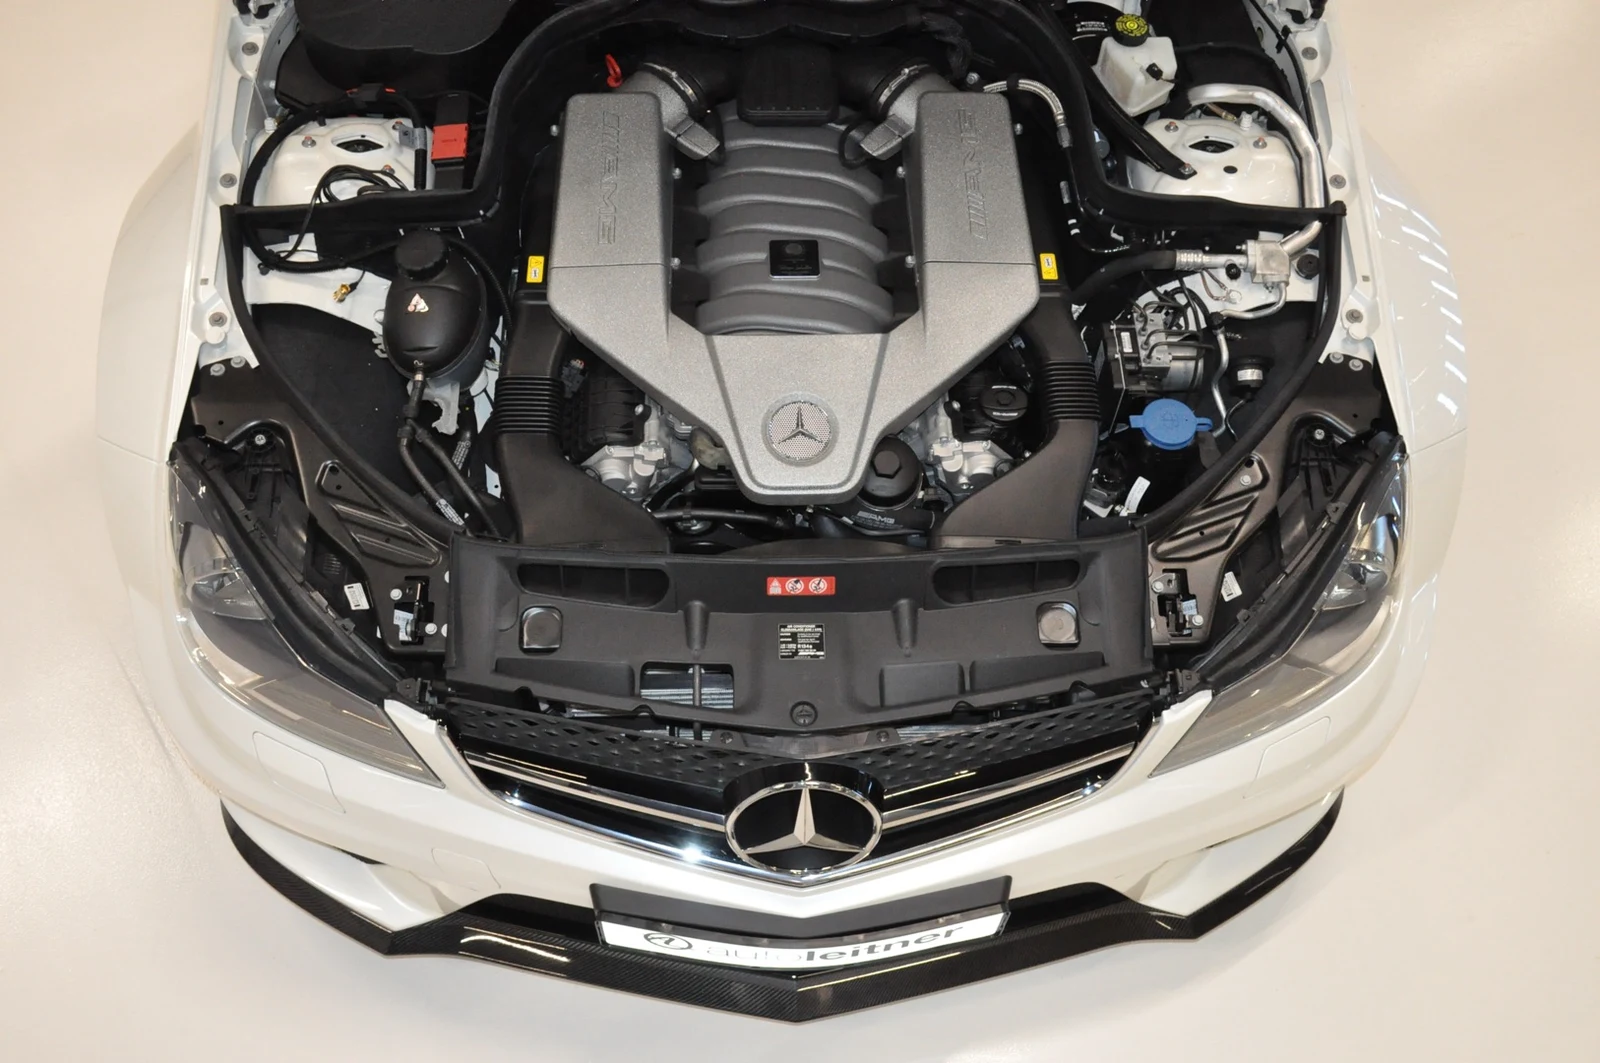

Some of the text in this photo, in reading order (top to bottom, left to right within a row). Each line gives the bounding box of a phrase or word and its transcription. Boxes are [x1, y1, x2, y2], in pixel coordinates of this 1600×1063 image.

[958, 109, 983, 198] AMG
[598, 153, 618, 245] AMG
[866, 512, 895, 525] AMG
